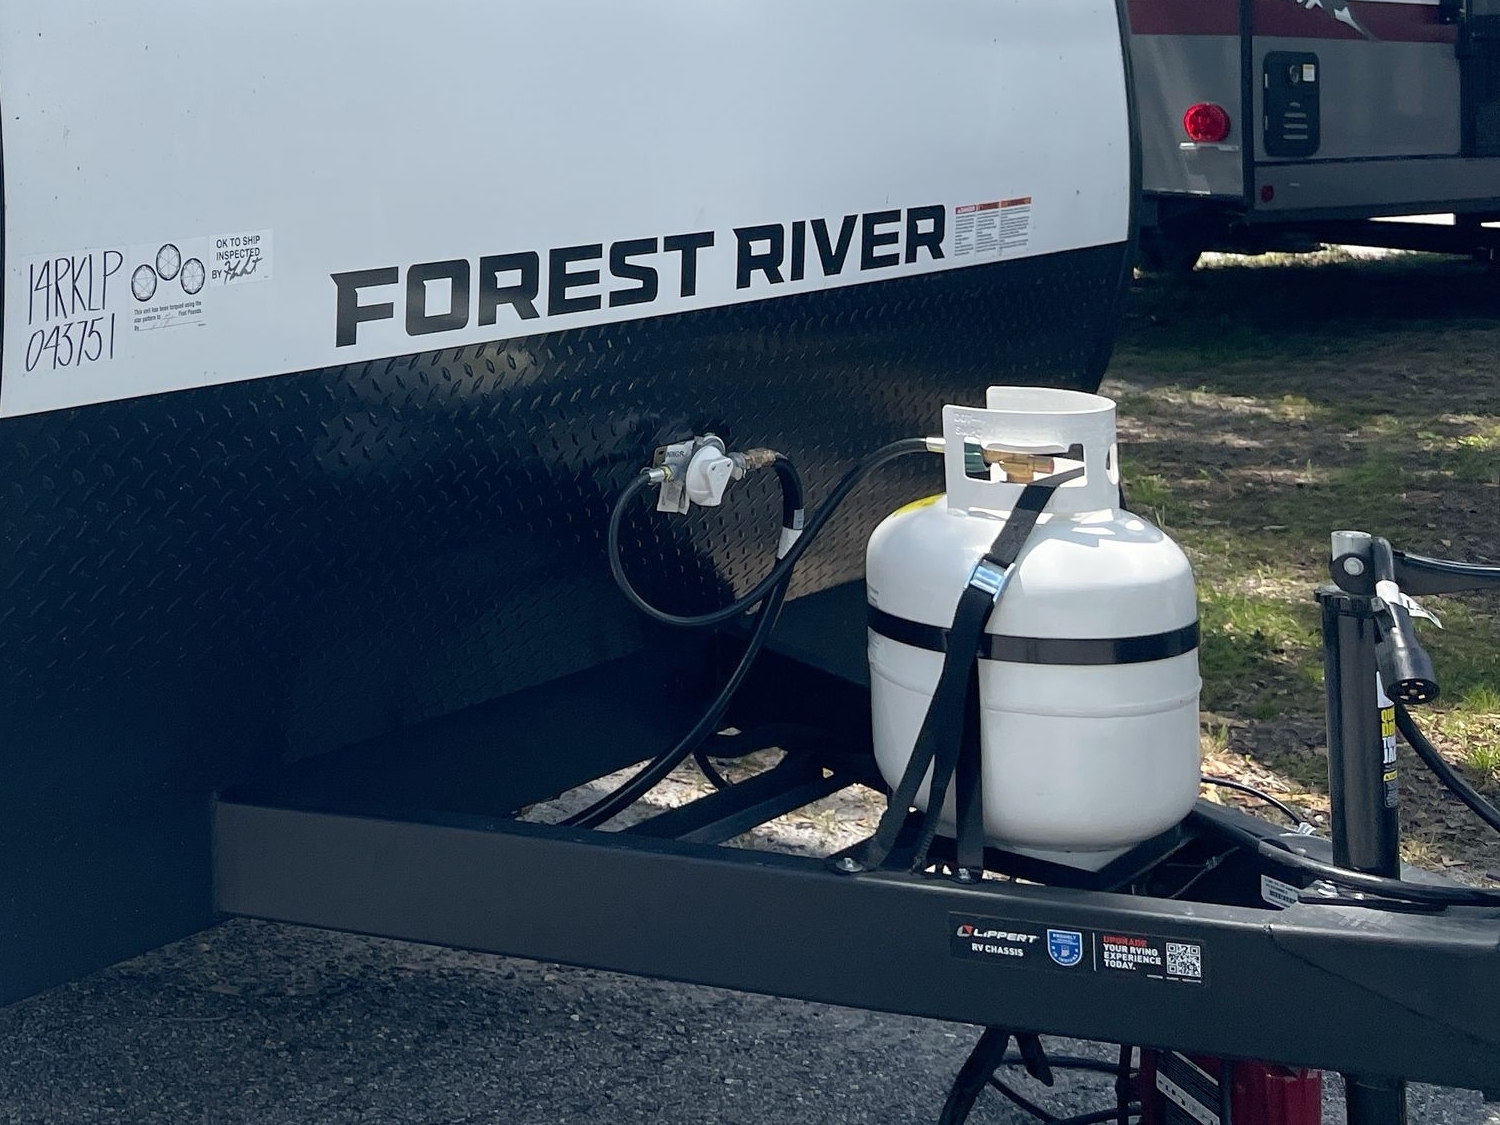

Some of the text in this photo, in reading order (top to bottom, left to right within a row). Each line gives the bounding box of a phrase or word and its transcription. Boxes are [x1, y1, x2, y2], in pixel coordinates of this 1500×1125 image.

[216, 235, 261, 249] OK TO SHIP
[216, 247, 260, 261] INSPECTED
[211, 269, 222, 280] BY
[328, 231, 715, 348] FOREST
[731, 203, 946, 290] RIVER
[28, 249, 124, 325] 14RKLP
[25, 313, 116, 372] 043751
[972, 927, 1038, 944] LIPPERT
[972, 942, 1024, 957] RV CHASSIS
[1103, 943, 1128, 953] YOUR
[1103, 951, 1162, 965] EXPERIENCE
[1103, 959, 1137, 971] TODAY.
